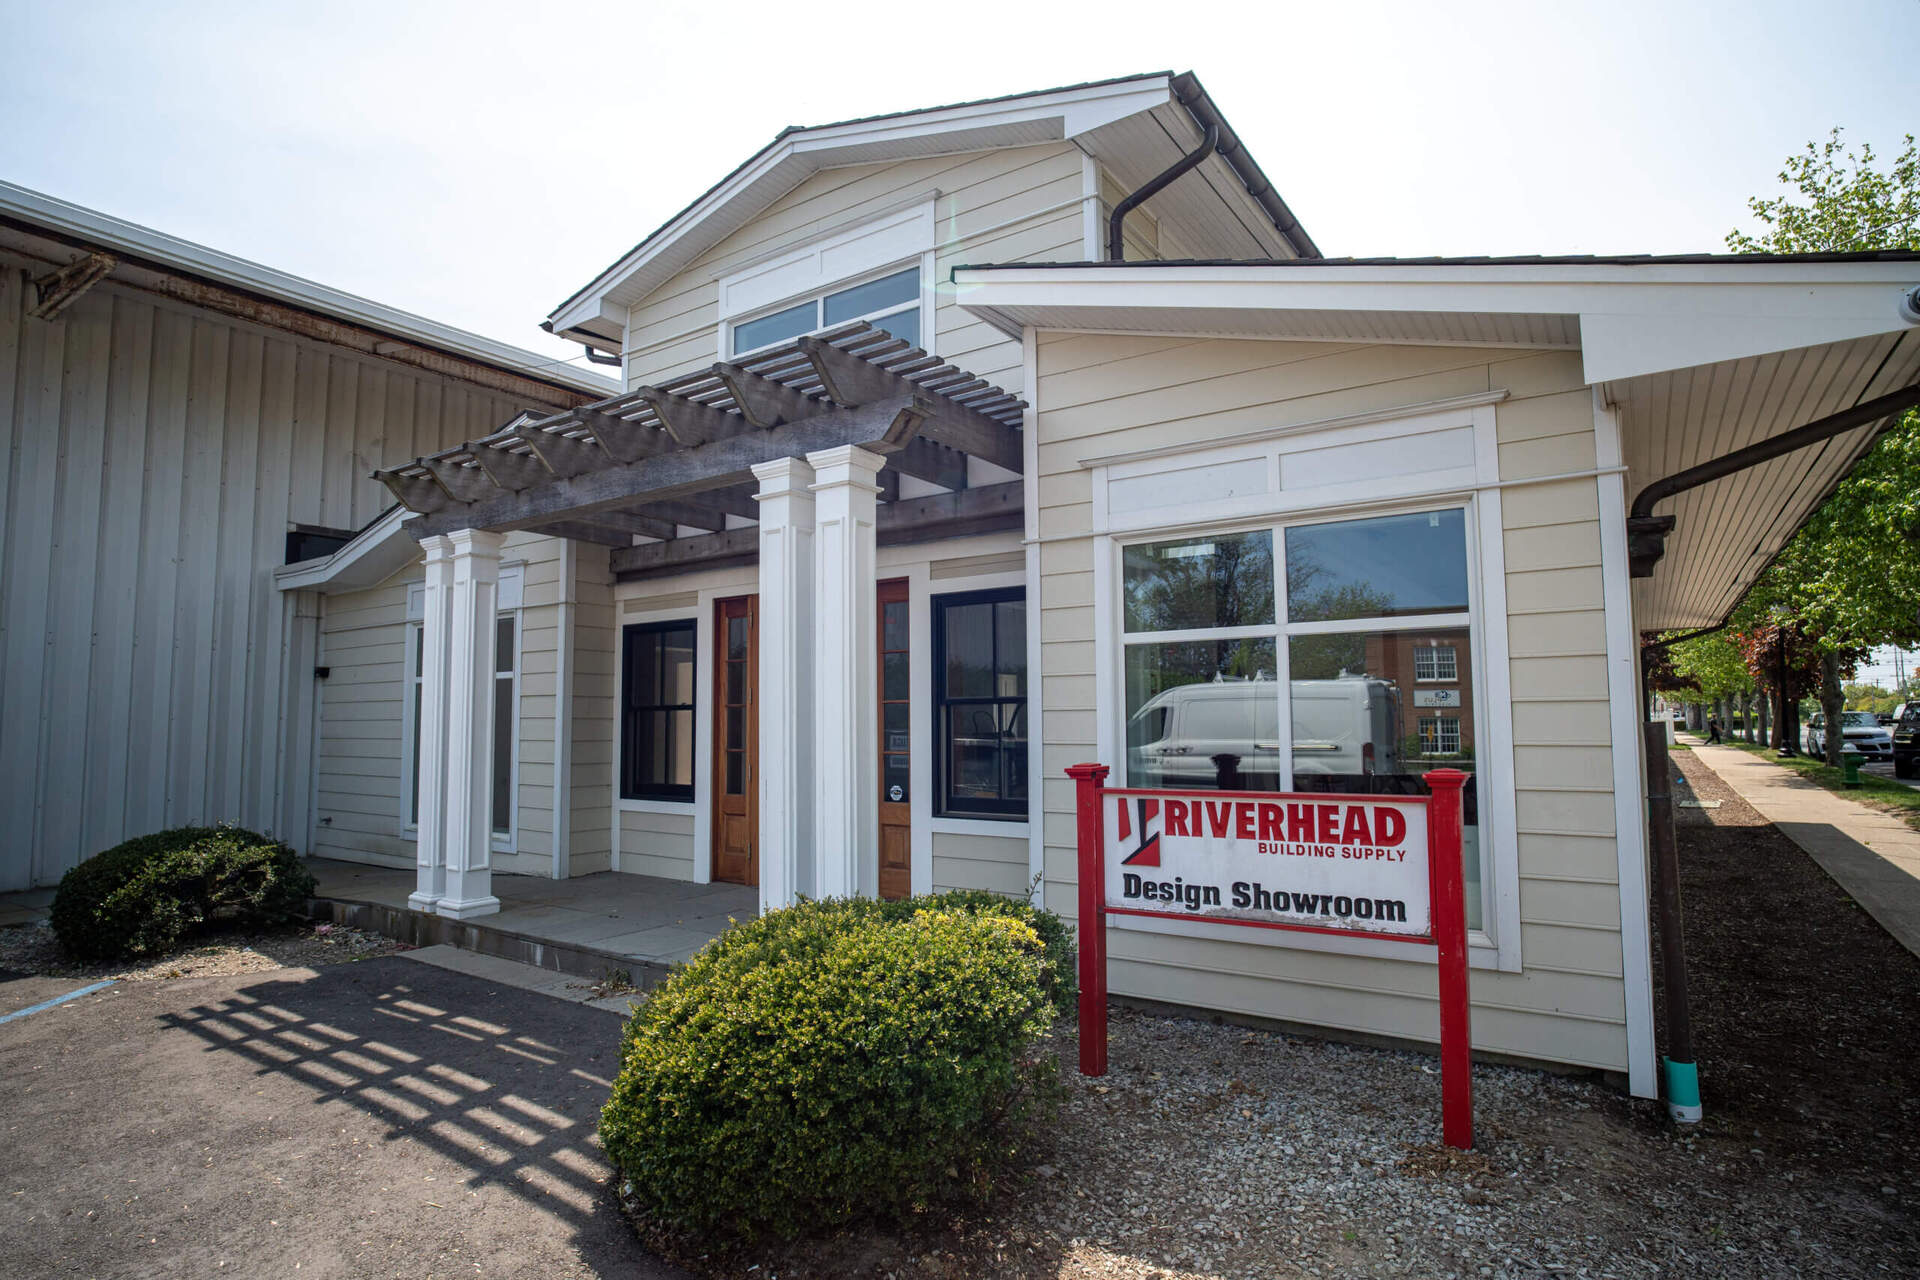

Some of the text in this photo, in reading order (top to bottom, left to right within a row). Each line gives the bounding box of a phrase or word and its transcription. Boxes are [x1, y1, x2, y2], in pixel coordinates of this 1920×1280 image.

[1164, 799, 1407, 847] RIVERHEAD
[1258, 843, 1407, 862] BUILDING SUPPLY
[1122, 873, 1407, 922] Design Showroom
